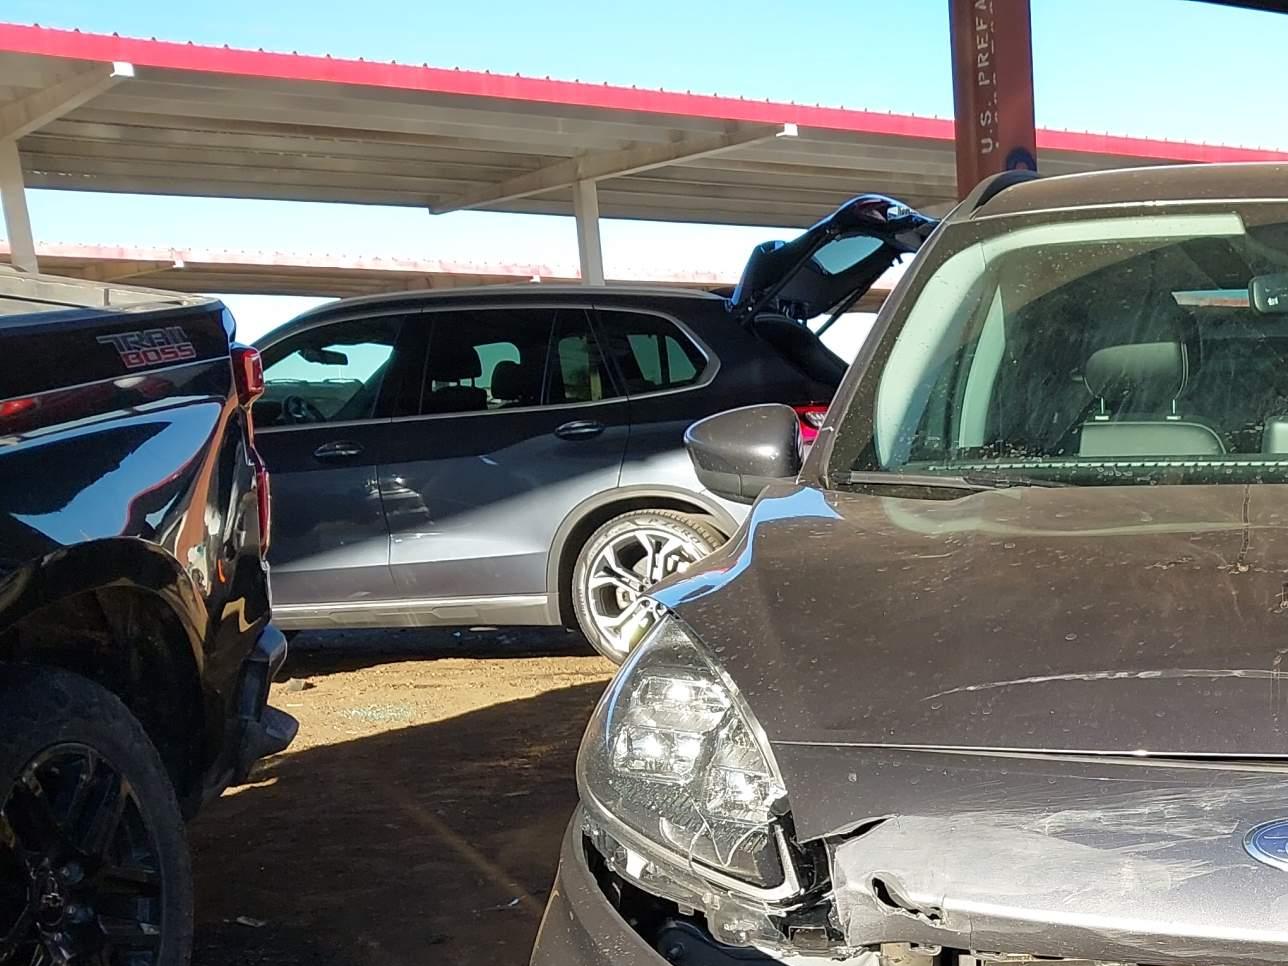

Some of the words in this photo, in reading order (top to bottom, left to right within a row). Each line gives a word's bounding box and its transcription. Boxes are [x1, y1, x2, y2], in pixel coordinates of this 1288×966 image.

[980, 101, 993, 154] U.S.
[96, 326, 188, 353] TRAIL
[120, 342, 197, 369] BOSS
